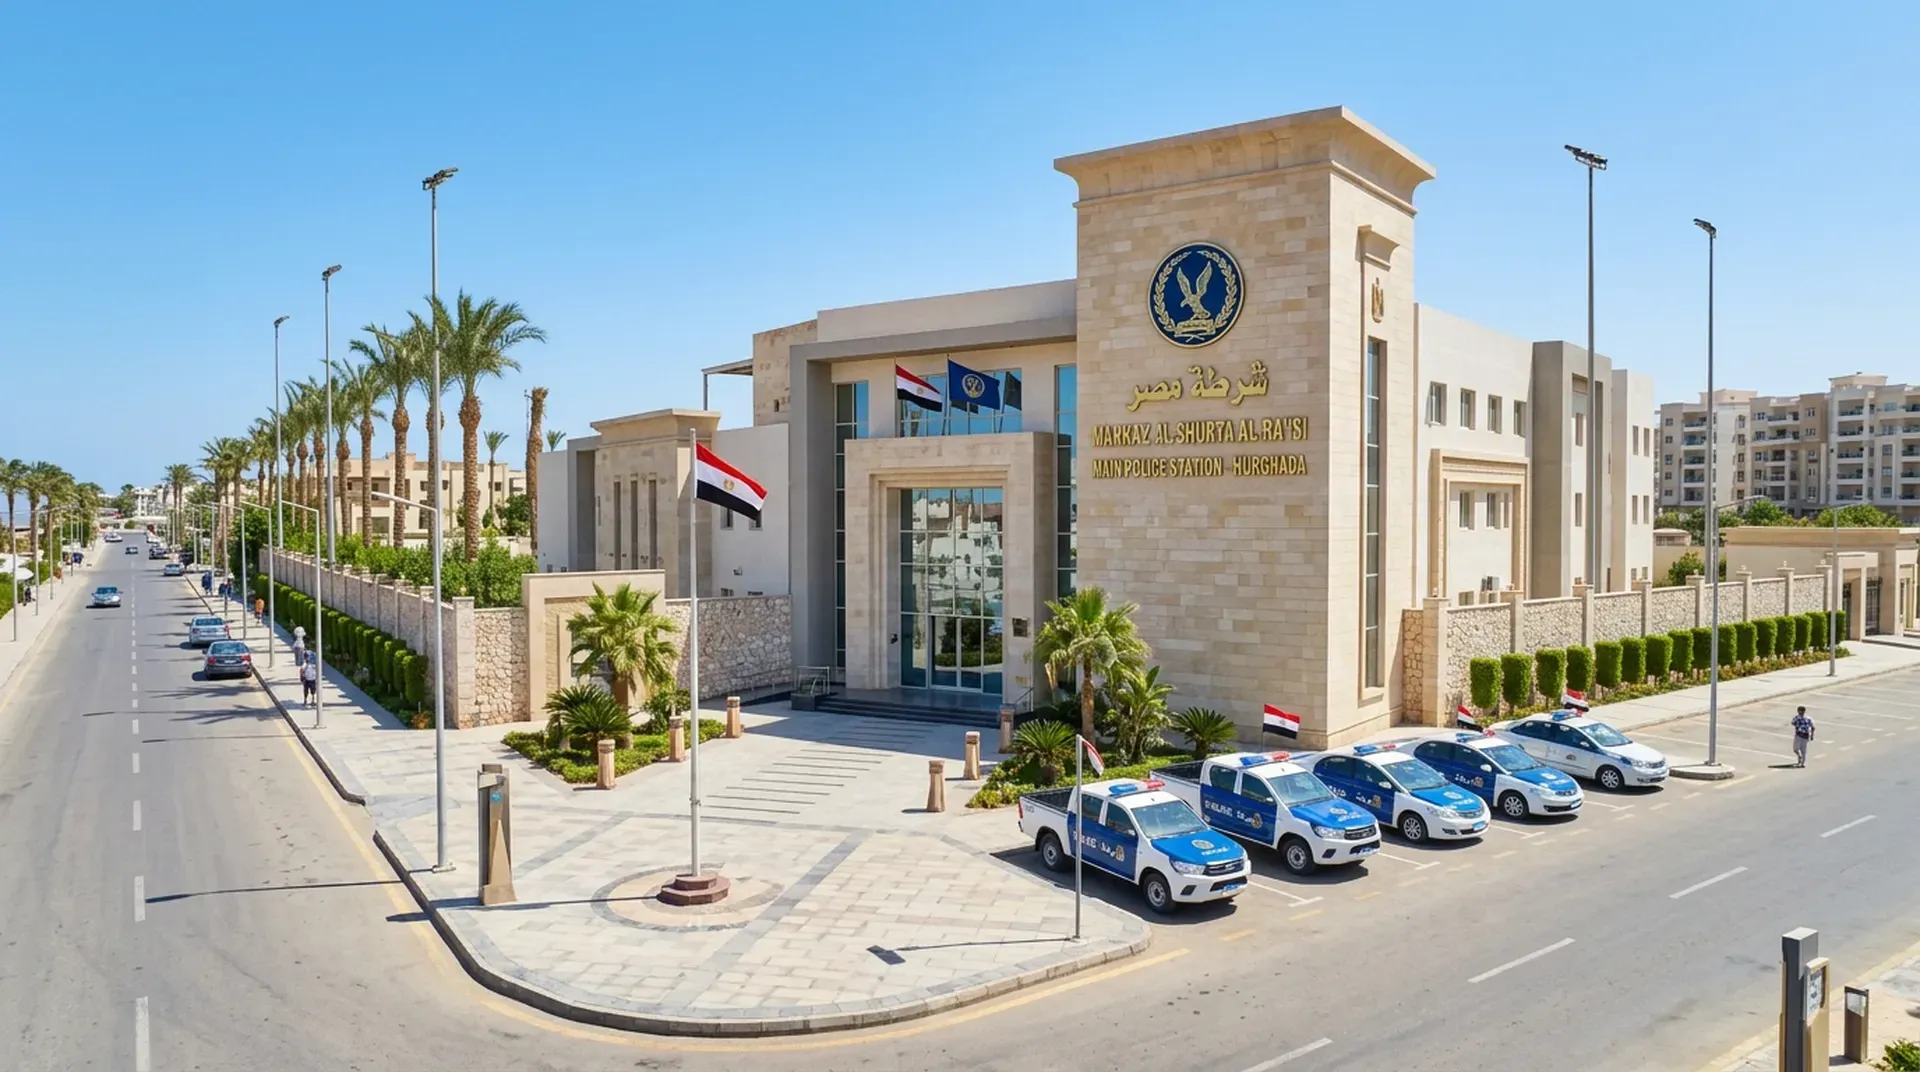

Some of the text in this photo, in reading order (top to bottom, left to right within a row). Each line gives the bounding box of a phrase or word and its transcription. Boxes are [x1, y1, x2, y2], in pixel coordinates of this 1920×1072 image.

[1126, 360, 1269, 412] شرطة مصر
[1092, 423, 1151, 447] MARKAZ
[1092, 454, 1307, 478] MAIN POLICE STATION HURGHADA
